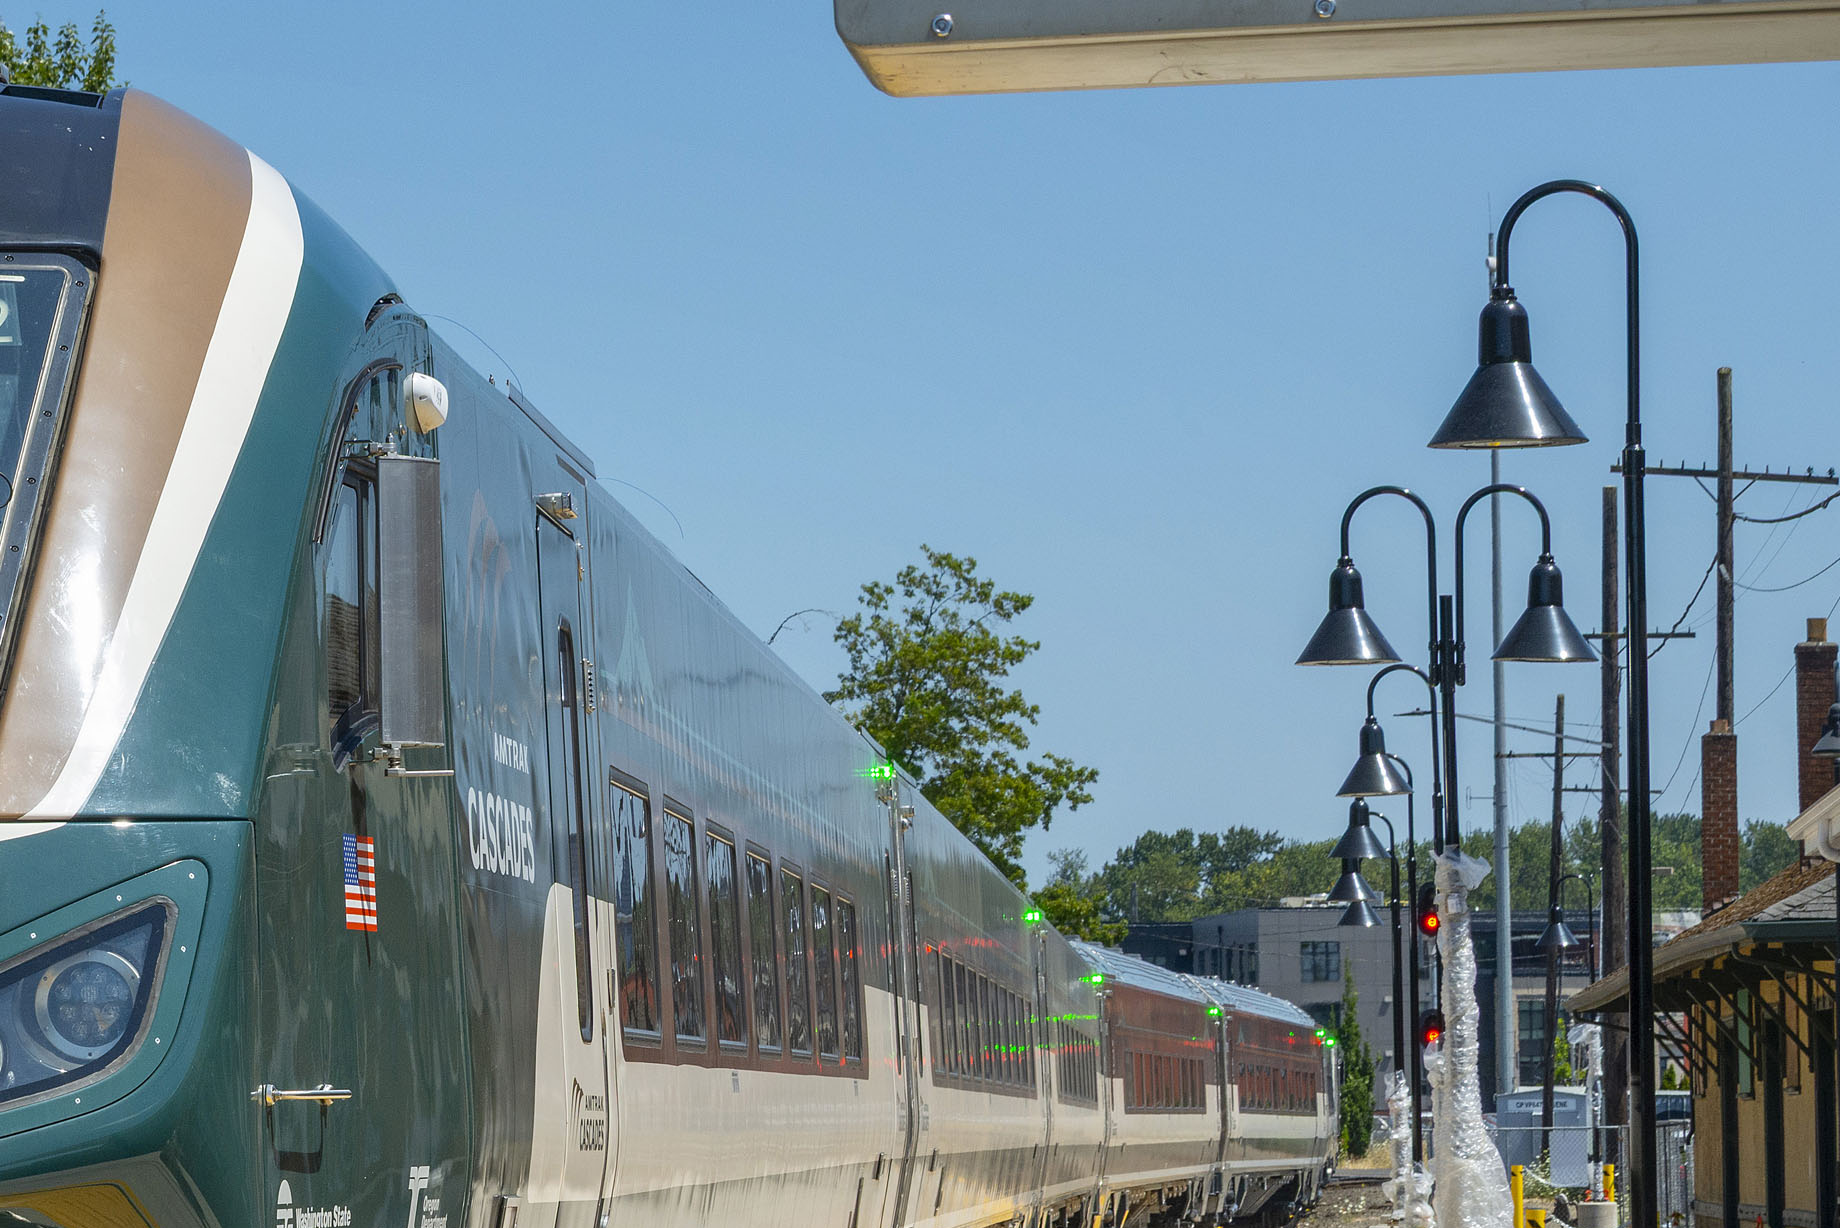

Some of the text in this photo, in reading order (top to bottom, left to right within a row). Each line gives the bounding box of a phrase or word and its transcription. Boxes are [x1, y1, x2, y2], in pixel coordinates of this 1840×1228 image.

[494, 732, 530, 775] AMTRAK
[468, 786, 535, 884] CASCADES
[585, 1095, 604, 1111] AMTRAK
[580, 1118, 604, 1151] CASCADES
[333, 1205, 351, 1227] State
[422, 1195, 440, 1215] Oregon
